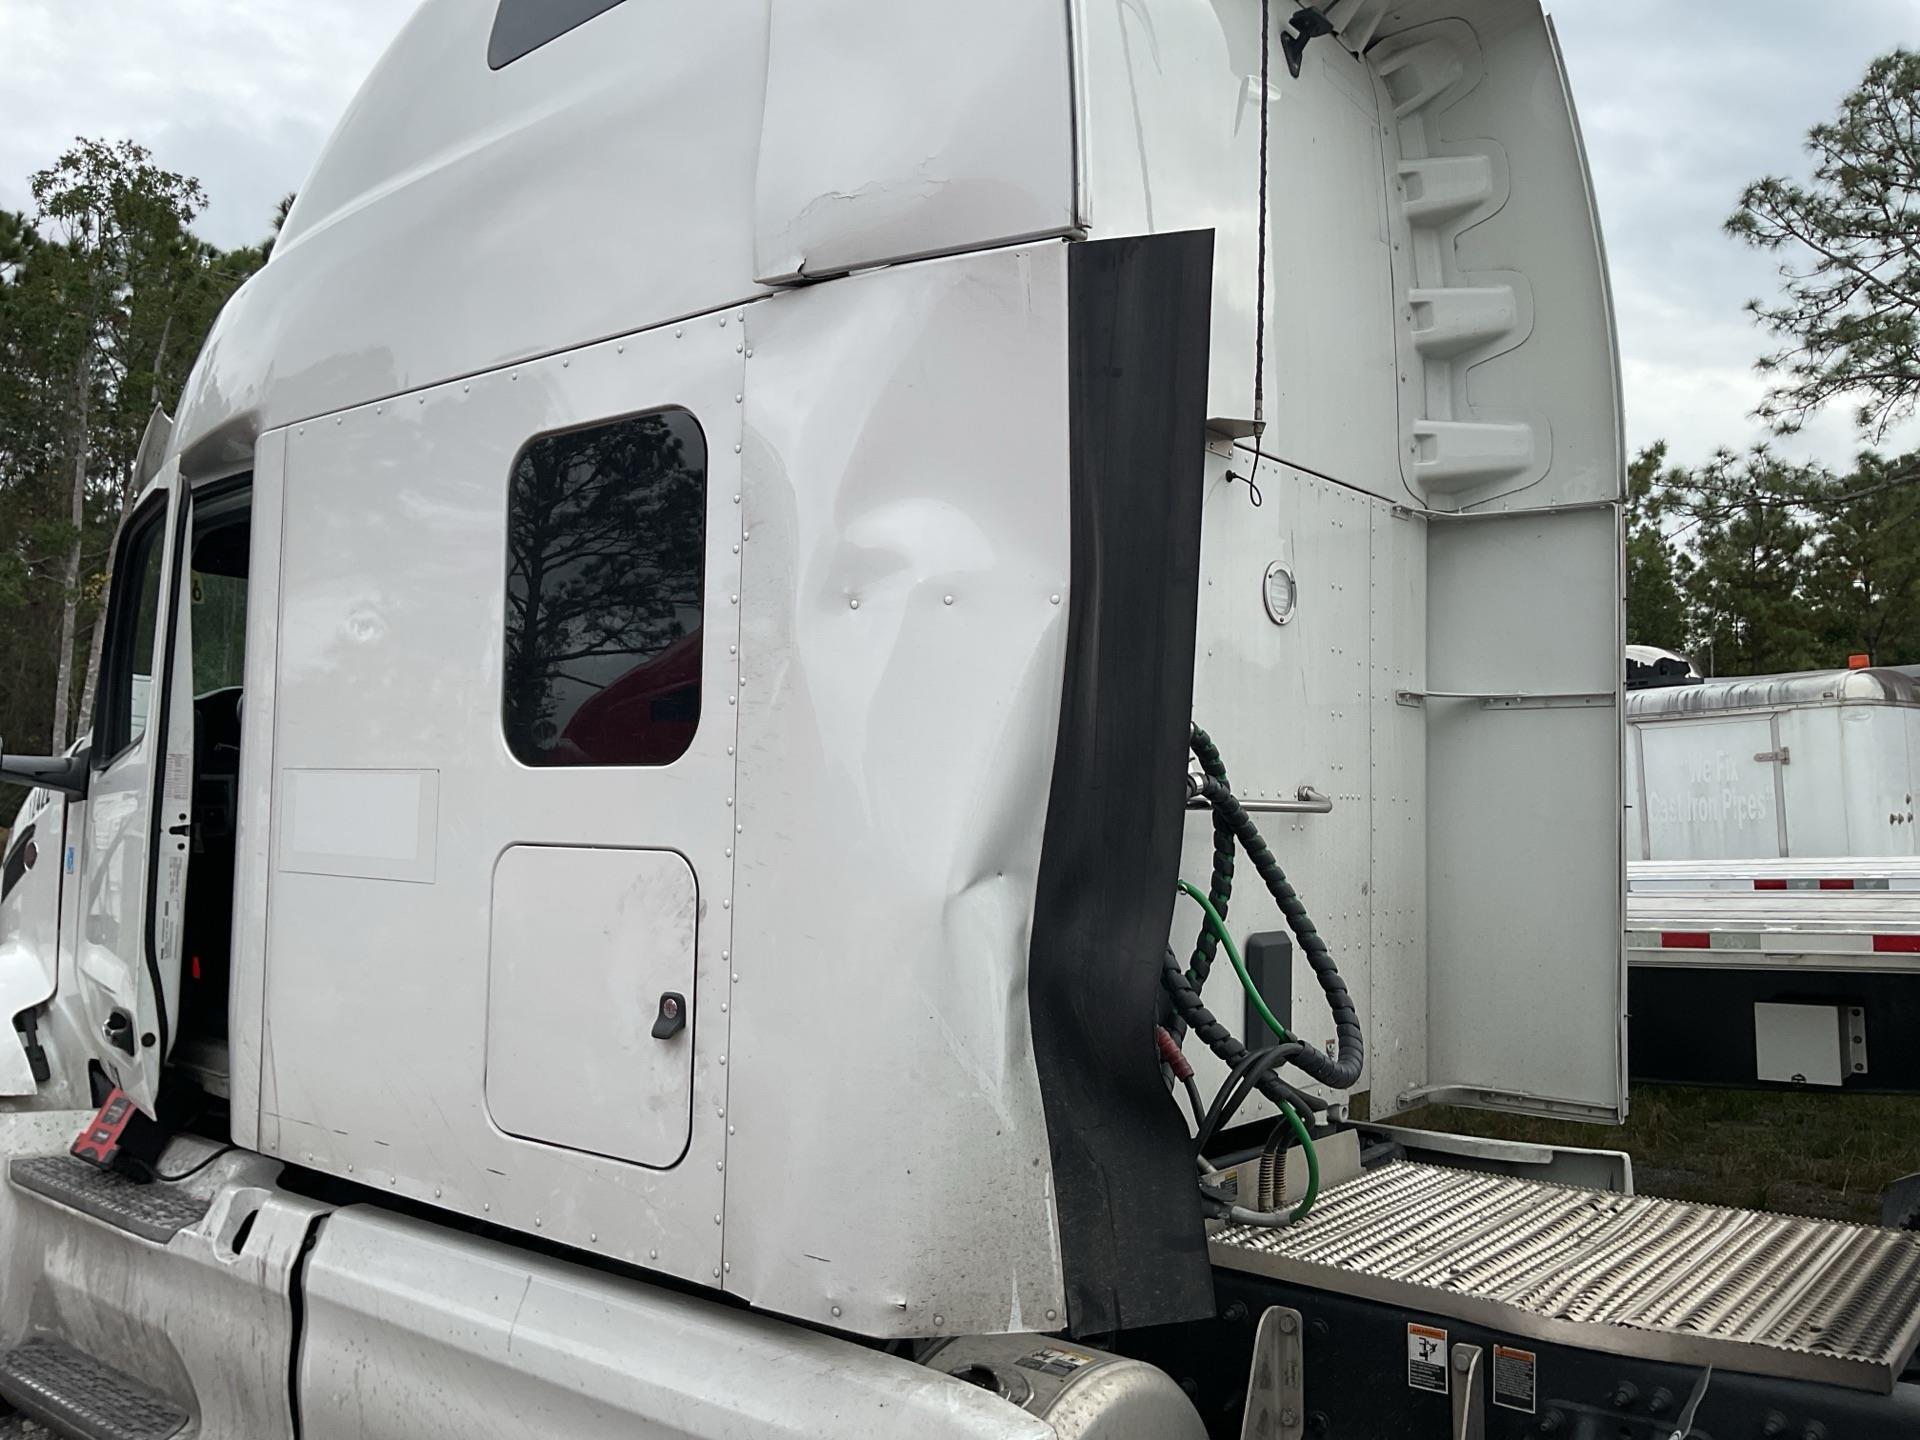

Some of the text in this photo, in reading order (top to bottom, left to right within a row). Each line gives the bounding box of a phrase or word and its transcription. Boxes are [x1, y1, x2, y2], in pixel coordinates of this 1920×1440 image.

[1717, 749, 1740, 782] Fix
[1648, 792, 1684, 823] Cast
[1687, 790, 1719, 822] Iron
